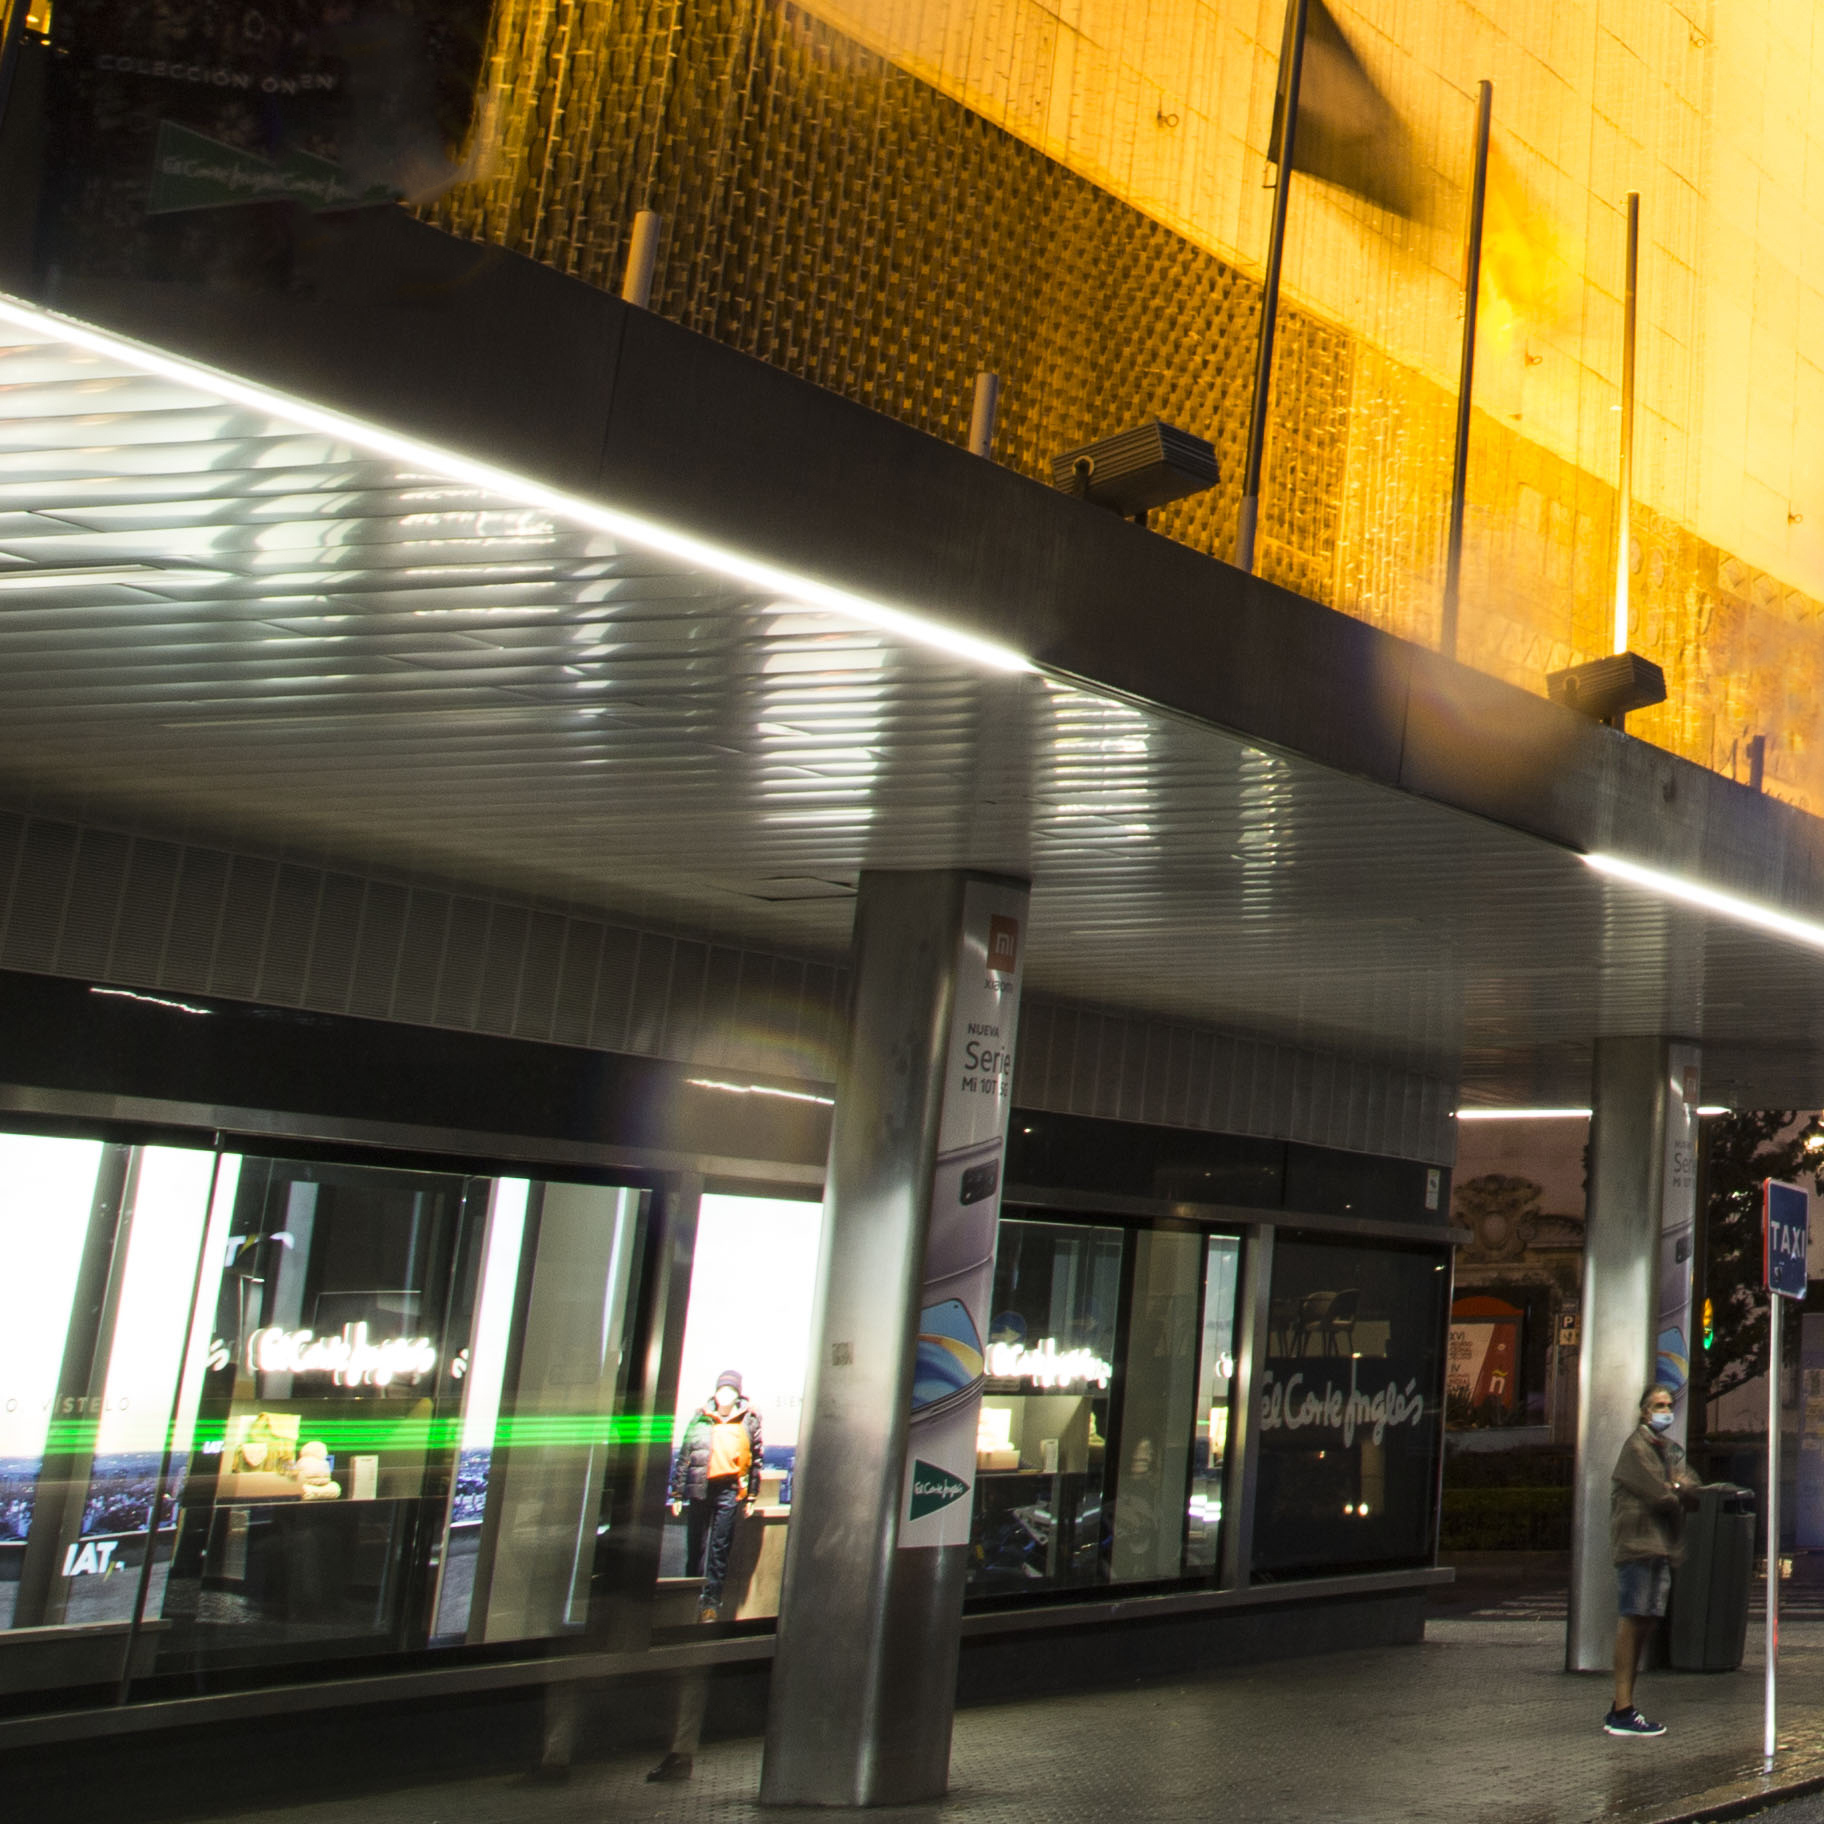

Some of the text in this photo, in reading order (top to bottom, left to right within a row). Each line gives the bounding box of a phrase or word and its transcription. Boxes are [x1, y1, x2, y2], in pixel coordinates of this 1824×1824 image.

[967, 1023, 1000, 1039] NUEVA
[964, 1040, 1012, 1076] Serie
[1771, 1220, 1807, 1259] TAXI
[1260, 1356, 1424, 1449] El Corte Inglés
